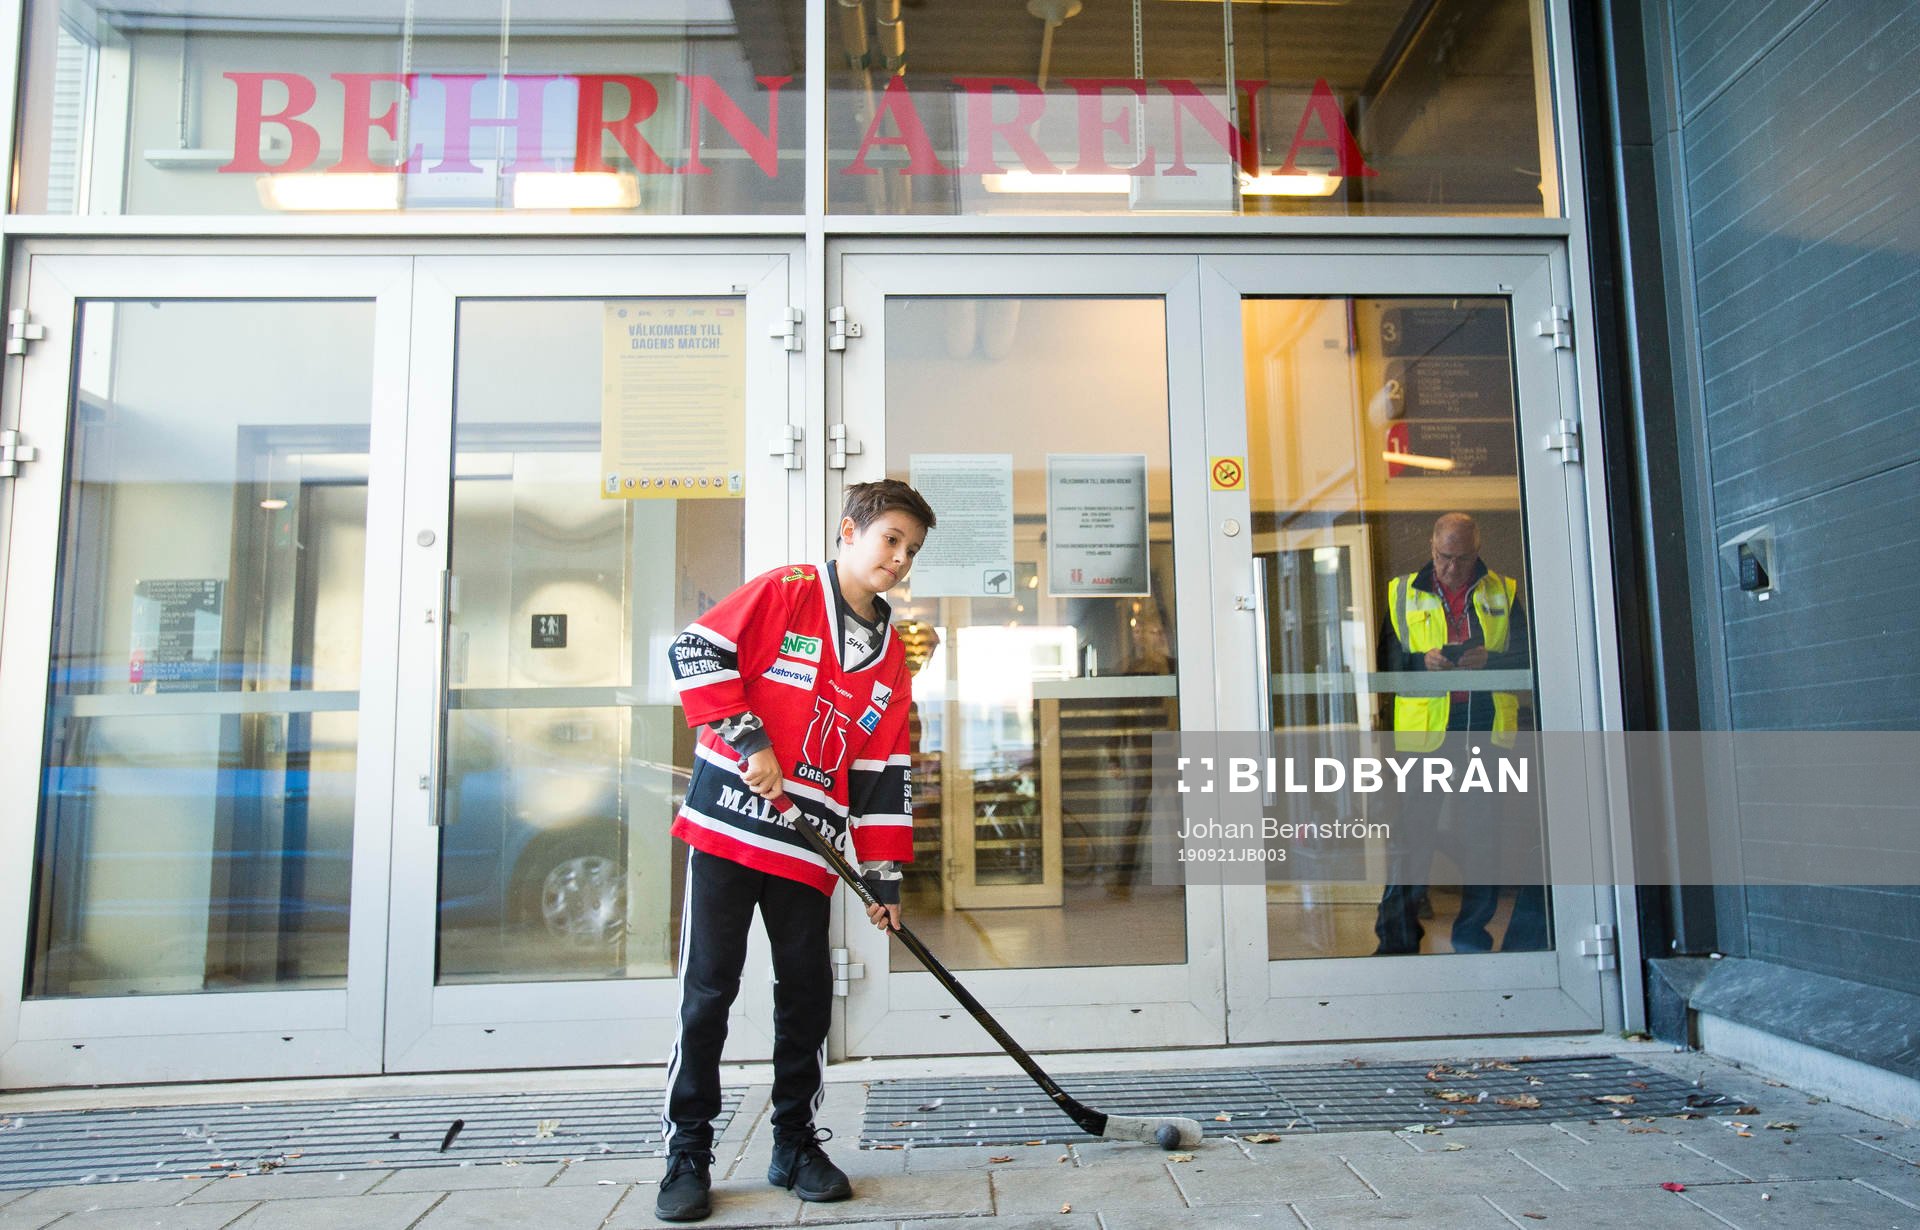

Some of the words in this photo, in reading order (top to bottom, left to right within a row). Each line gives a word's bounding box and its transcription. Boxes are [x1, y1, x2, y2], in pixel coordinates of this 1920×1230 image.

[218, 72, 792, 178] BEHRN
[840, 74, 1379, 178] ARENA
[628, 323, 697, 336] VÄLKOMMEN
[700, 324, 723, 336] TILL
[1383, 322, 1397, 342] 3
[631, 338, 674, 349] DAGENS
[678, 338, 720, 349] MATCH!
[675, 646, 702, 661] SOM
[846, 637, 865, 654] SHL
[764, 666, 813, 684] ustavsvik
